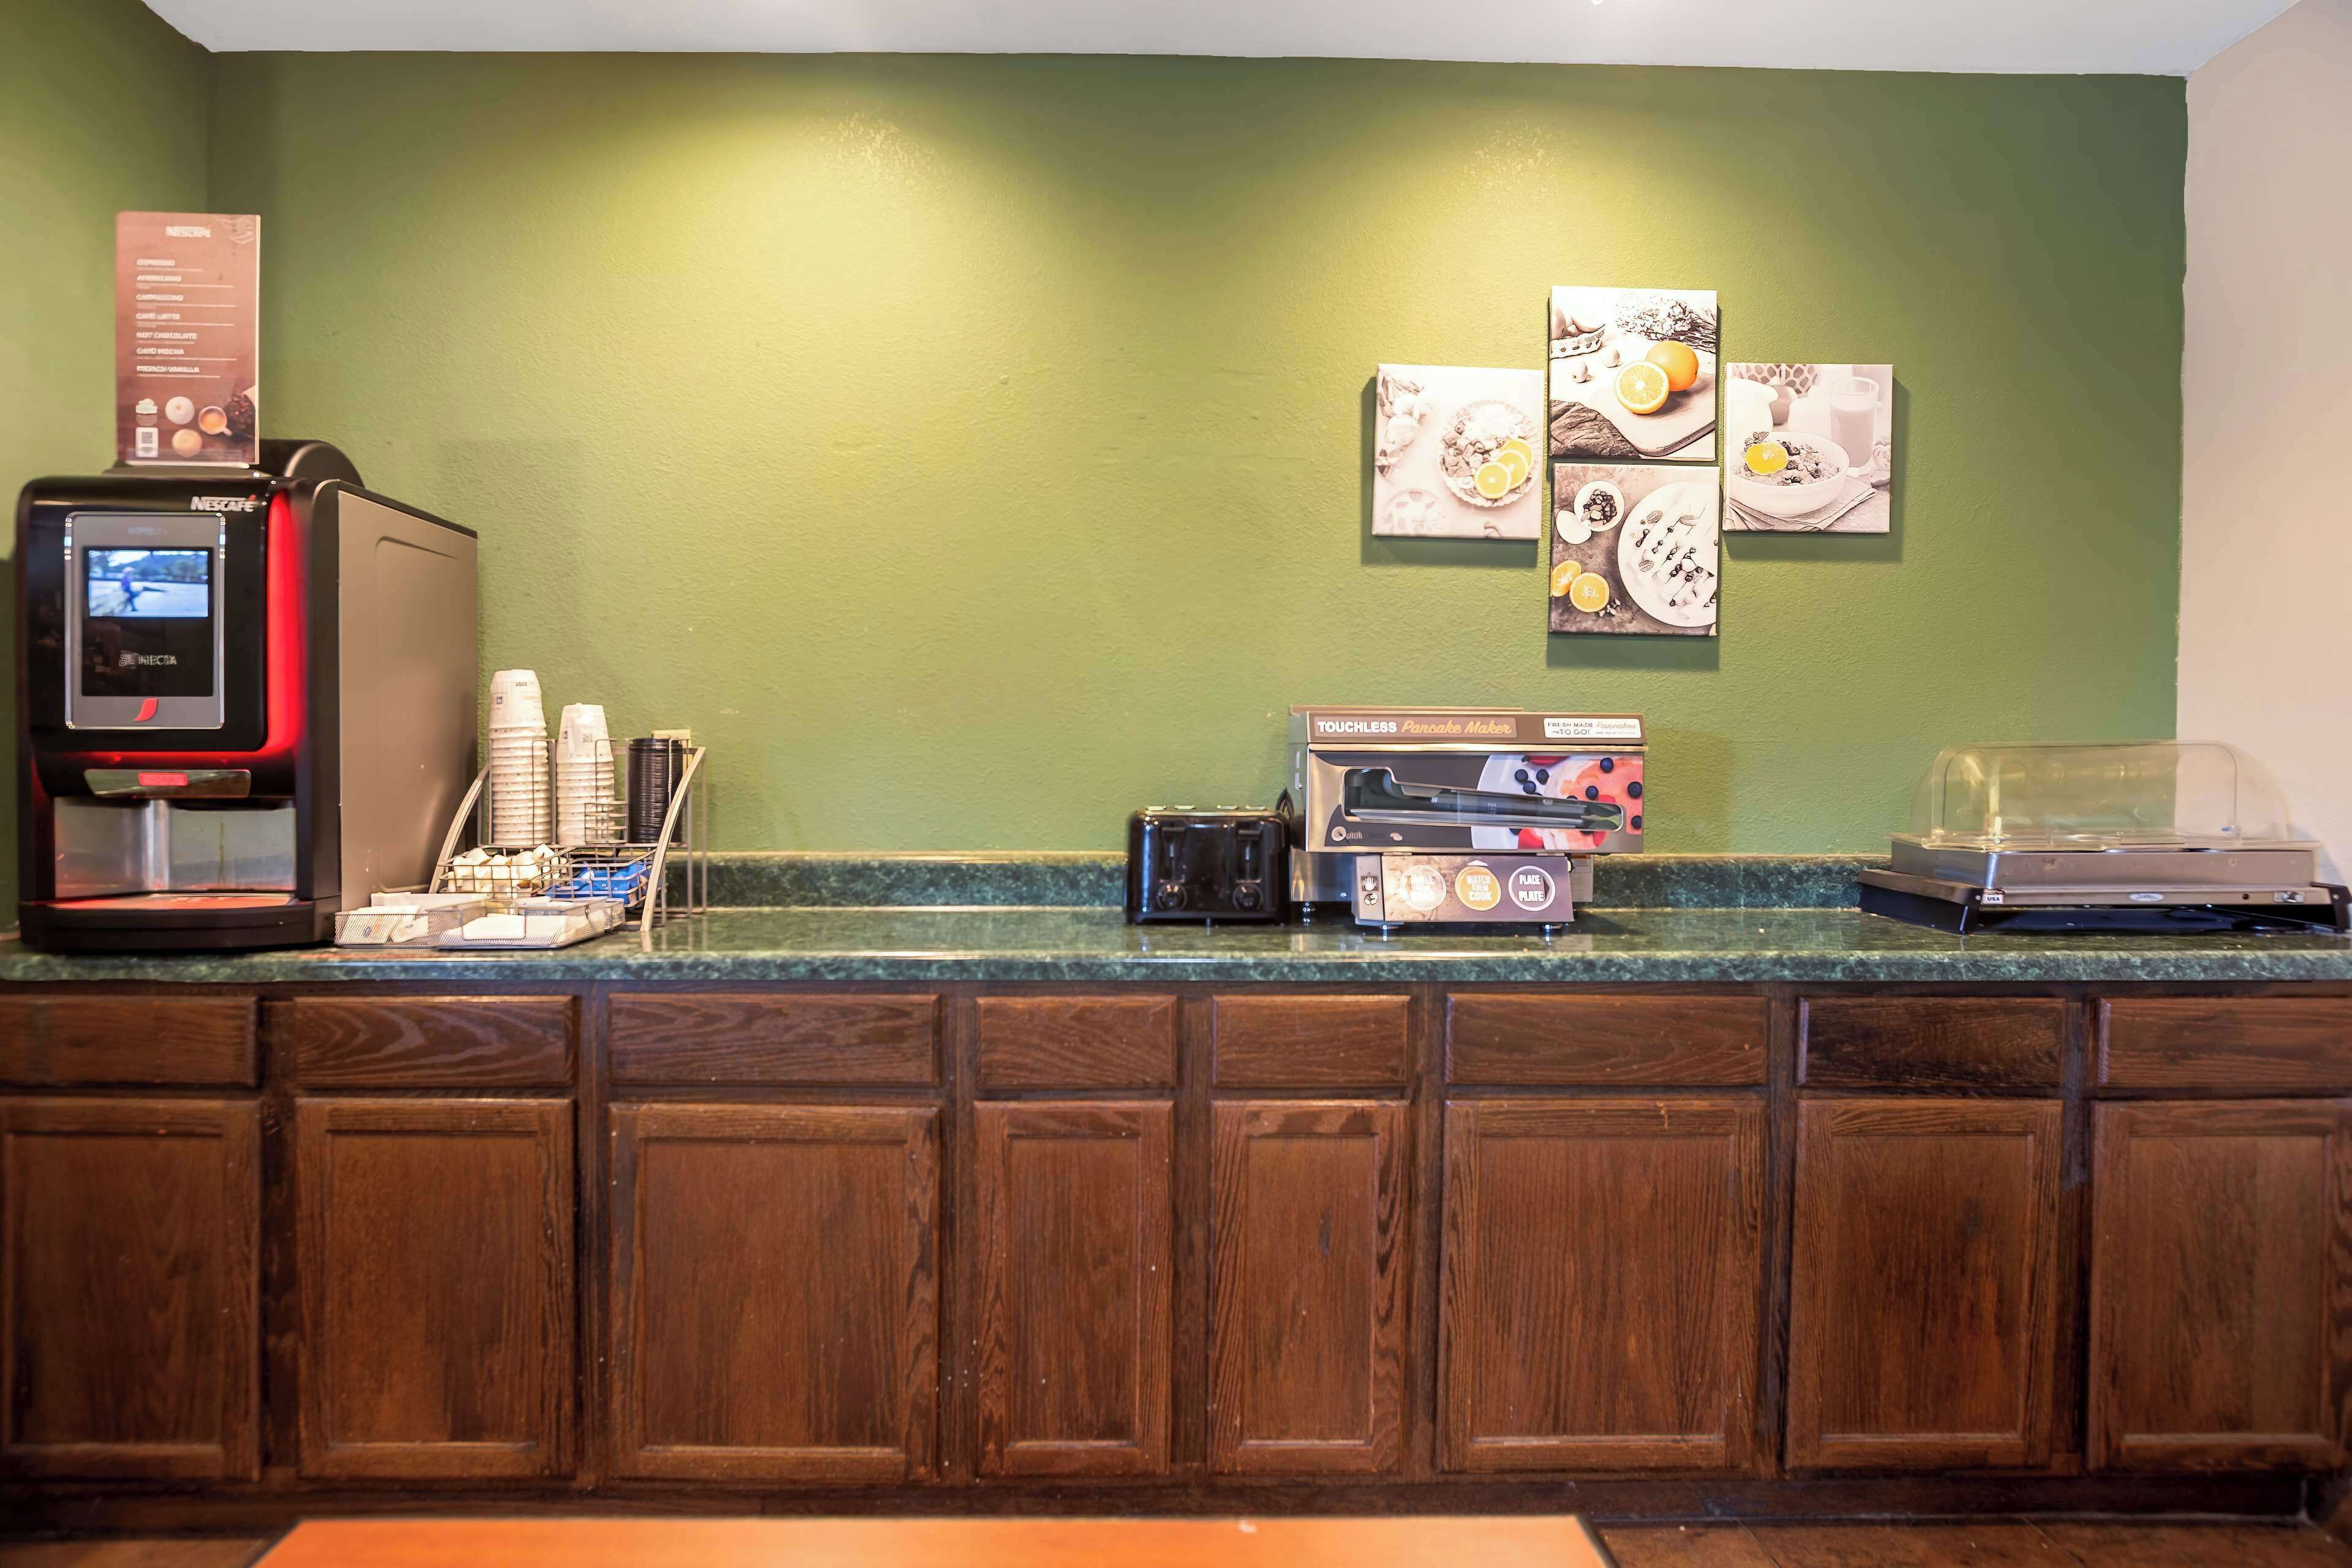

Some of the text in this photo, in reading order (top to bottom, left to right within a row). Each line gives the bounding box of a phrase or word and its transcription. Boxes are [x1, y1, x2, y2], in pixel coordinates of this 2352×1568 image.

[1317, 720, 1512, 734] TOUCHLESS Pancake Maker
[1519, 891, 1544, 902] PLATE
